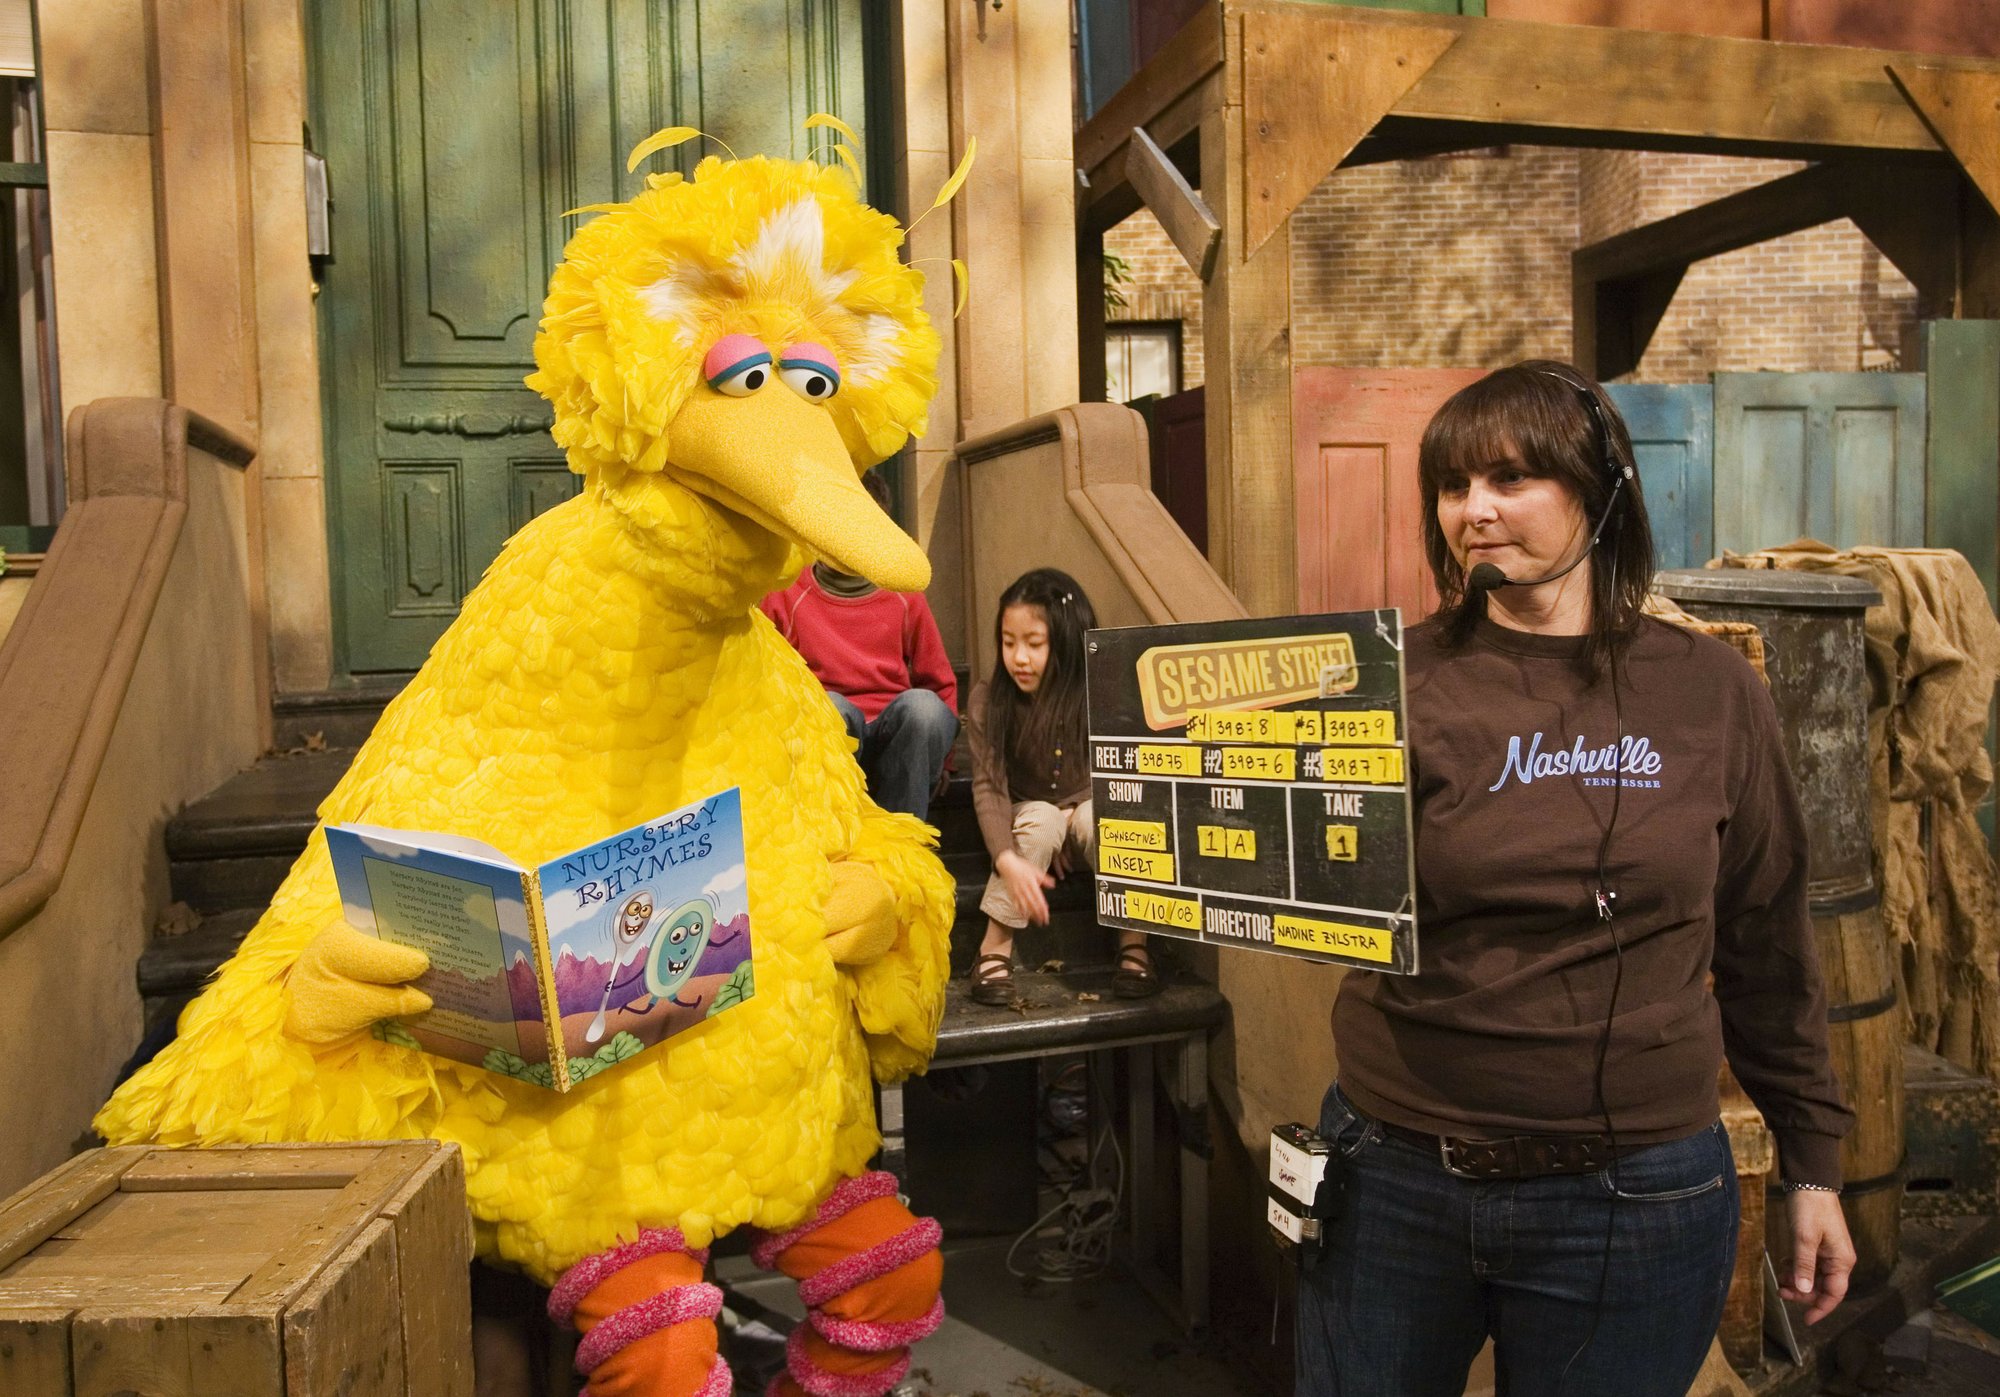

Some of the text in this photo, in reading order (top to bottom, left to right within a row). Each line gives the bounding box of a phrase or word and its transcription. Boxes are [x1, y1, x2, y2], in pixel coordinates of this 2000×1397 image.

[1158, 642, 1349, 708] SESAME STREET
[1186, 714, 1207, 736] #4
[1296, 716, 1316, 736] #5
[1329, 718, 1385, 738] 39879
[1095, 746, 1123, 769] REEL
[1142, 752, 1183, 770] 39875
[1204, 749, 1223, 774] #2
[1228, 753, 1284, 775] 39876
[1328, 756, 1387, 778] 39877
[1489, 732, 1662, 792] Nashville
[1109, 781, 1143, 803] SHOW
[1583, 777, 1661, 789] TENNESSEE
[1211, 787, 1244, 810] ITEM
[1323, 793, 1364, 817] TAKE
[562, 798, 719, 883] NURSERY
[1205, 831, 1246, 853] 1 A
[1334, 835, 1352, 858] 1
[576, 832, 713, 908] RHYMES
[1108, 854, 1153, 875] INSERT
[1099, 891, 1128, 918] DATE
[1277, 925, 1379, 950] NADINE ZYLSTRA
